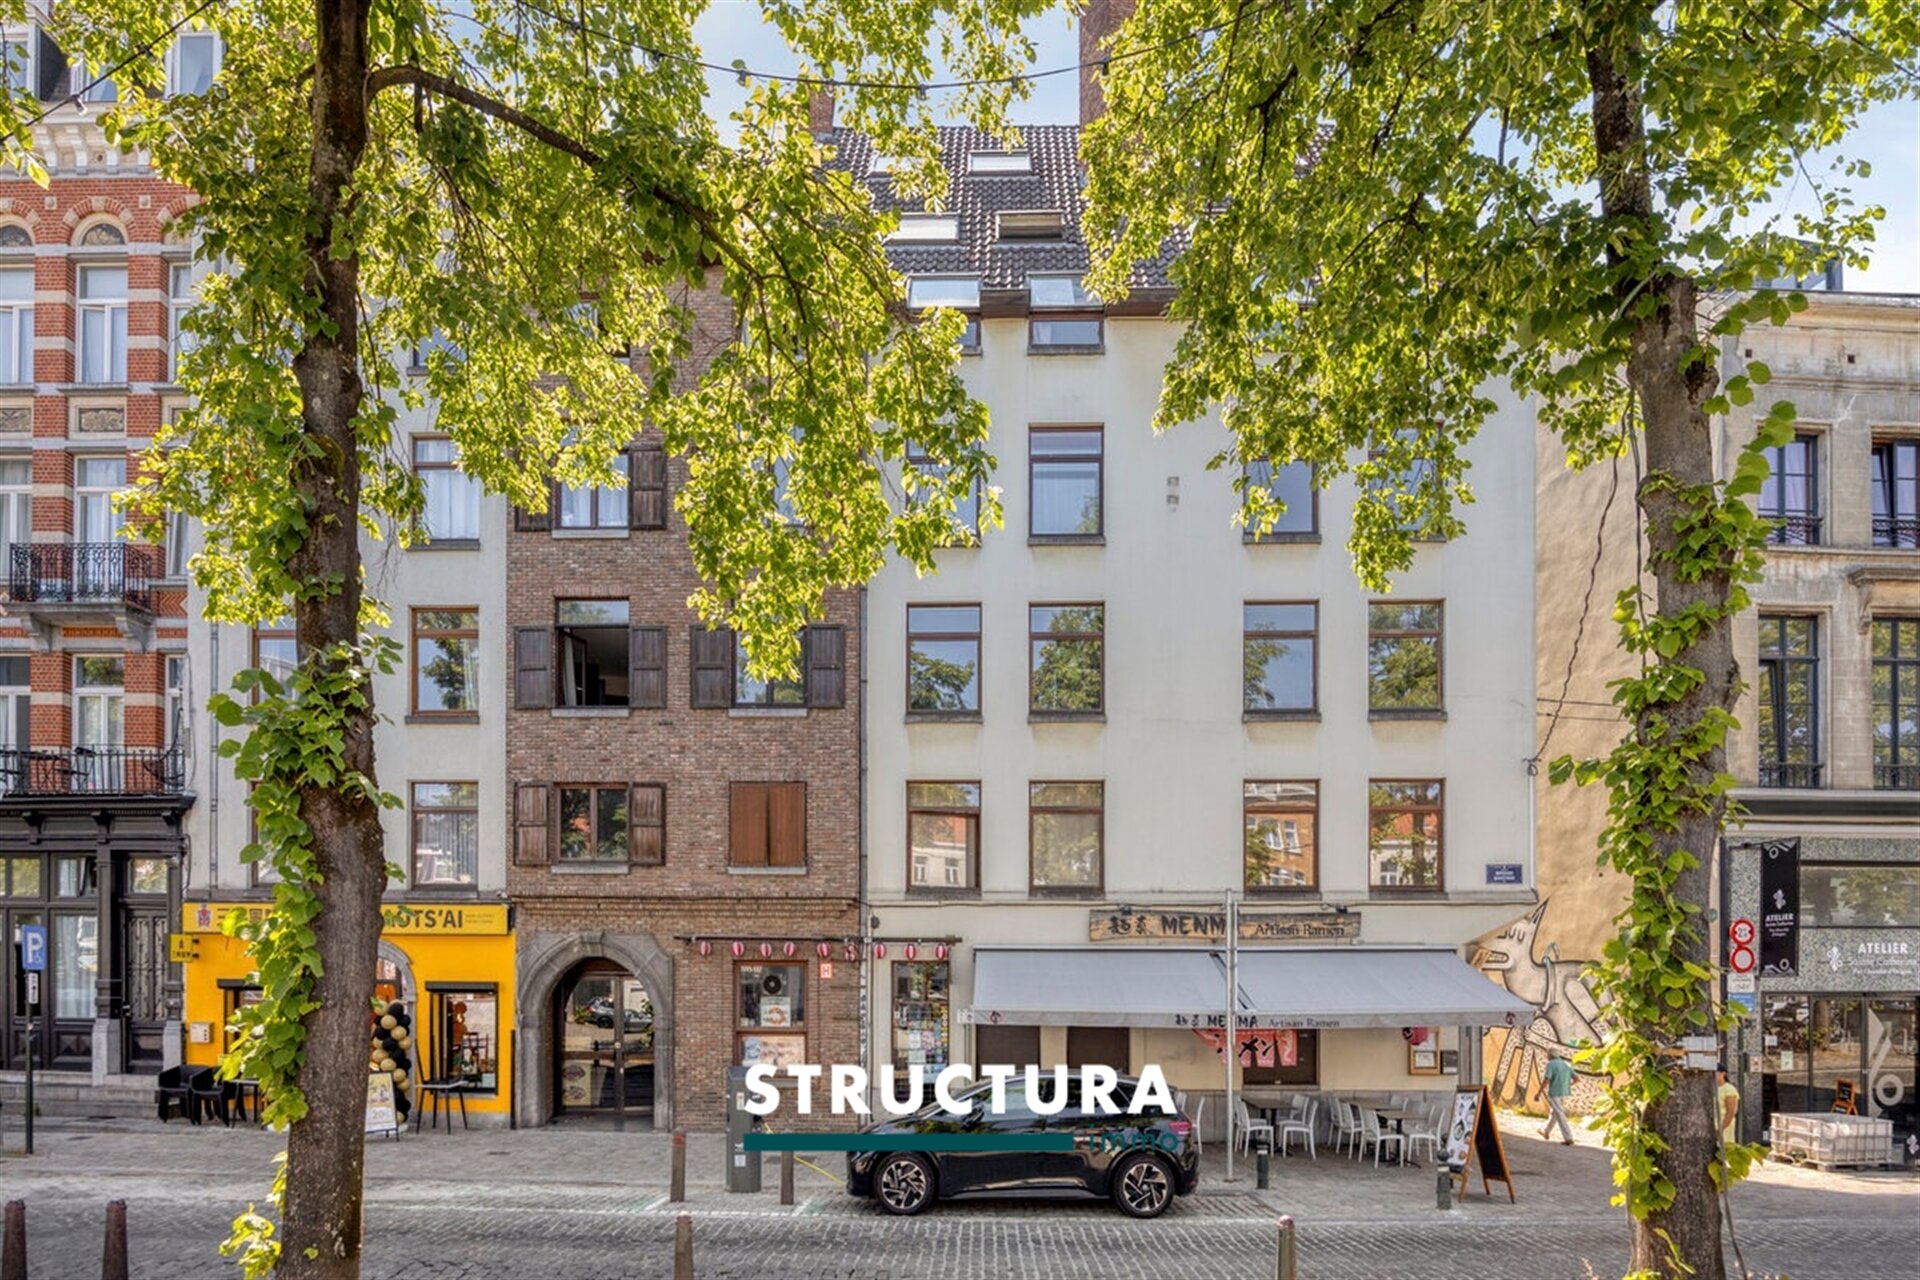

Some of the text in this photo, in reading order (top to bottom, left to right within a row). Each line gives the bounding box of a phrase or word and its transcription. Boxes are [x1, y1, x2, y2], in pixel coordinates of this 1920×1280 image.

[1765, 913, 1794, 922] ATELIER
[1161, 915, 1345, 936] MENM Artisan Ramen
[26, 932, 44, 964] P
[1857, 942, 1909, 955] ATELIER
[1207, 1014, 1259, 1028] MEMA
[1269, 1018, 1303, 1028] Artisan
[1306, 1018, 1340, 1028] Ramen
